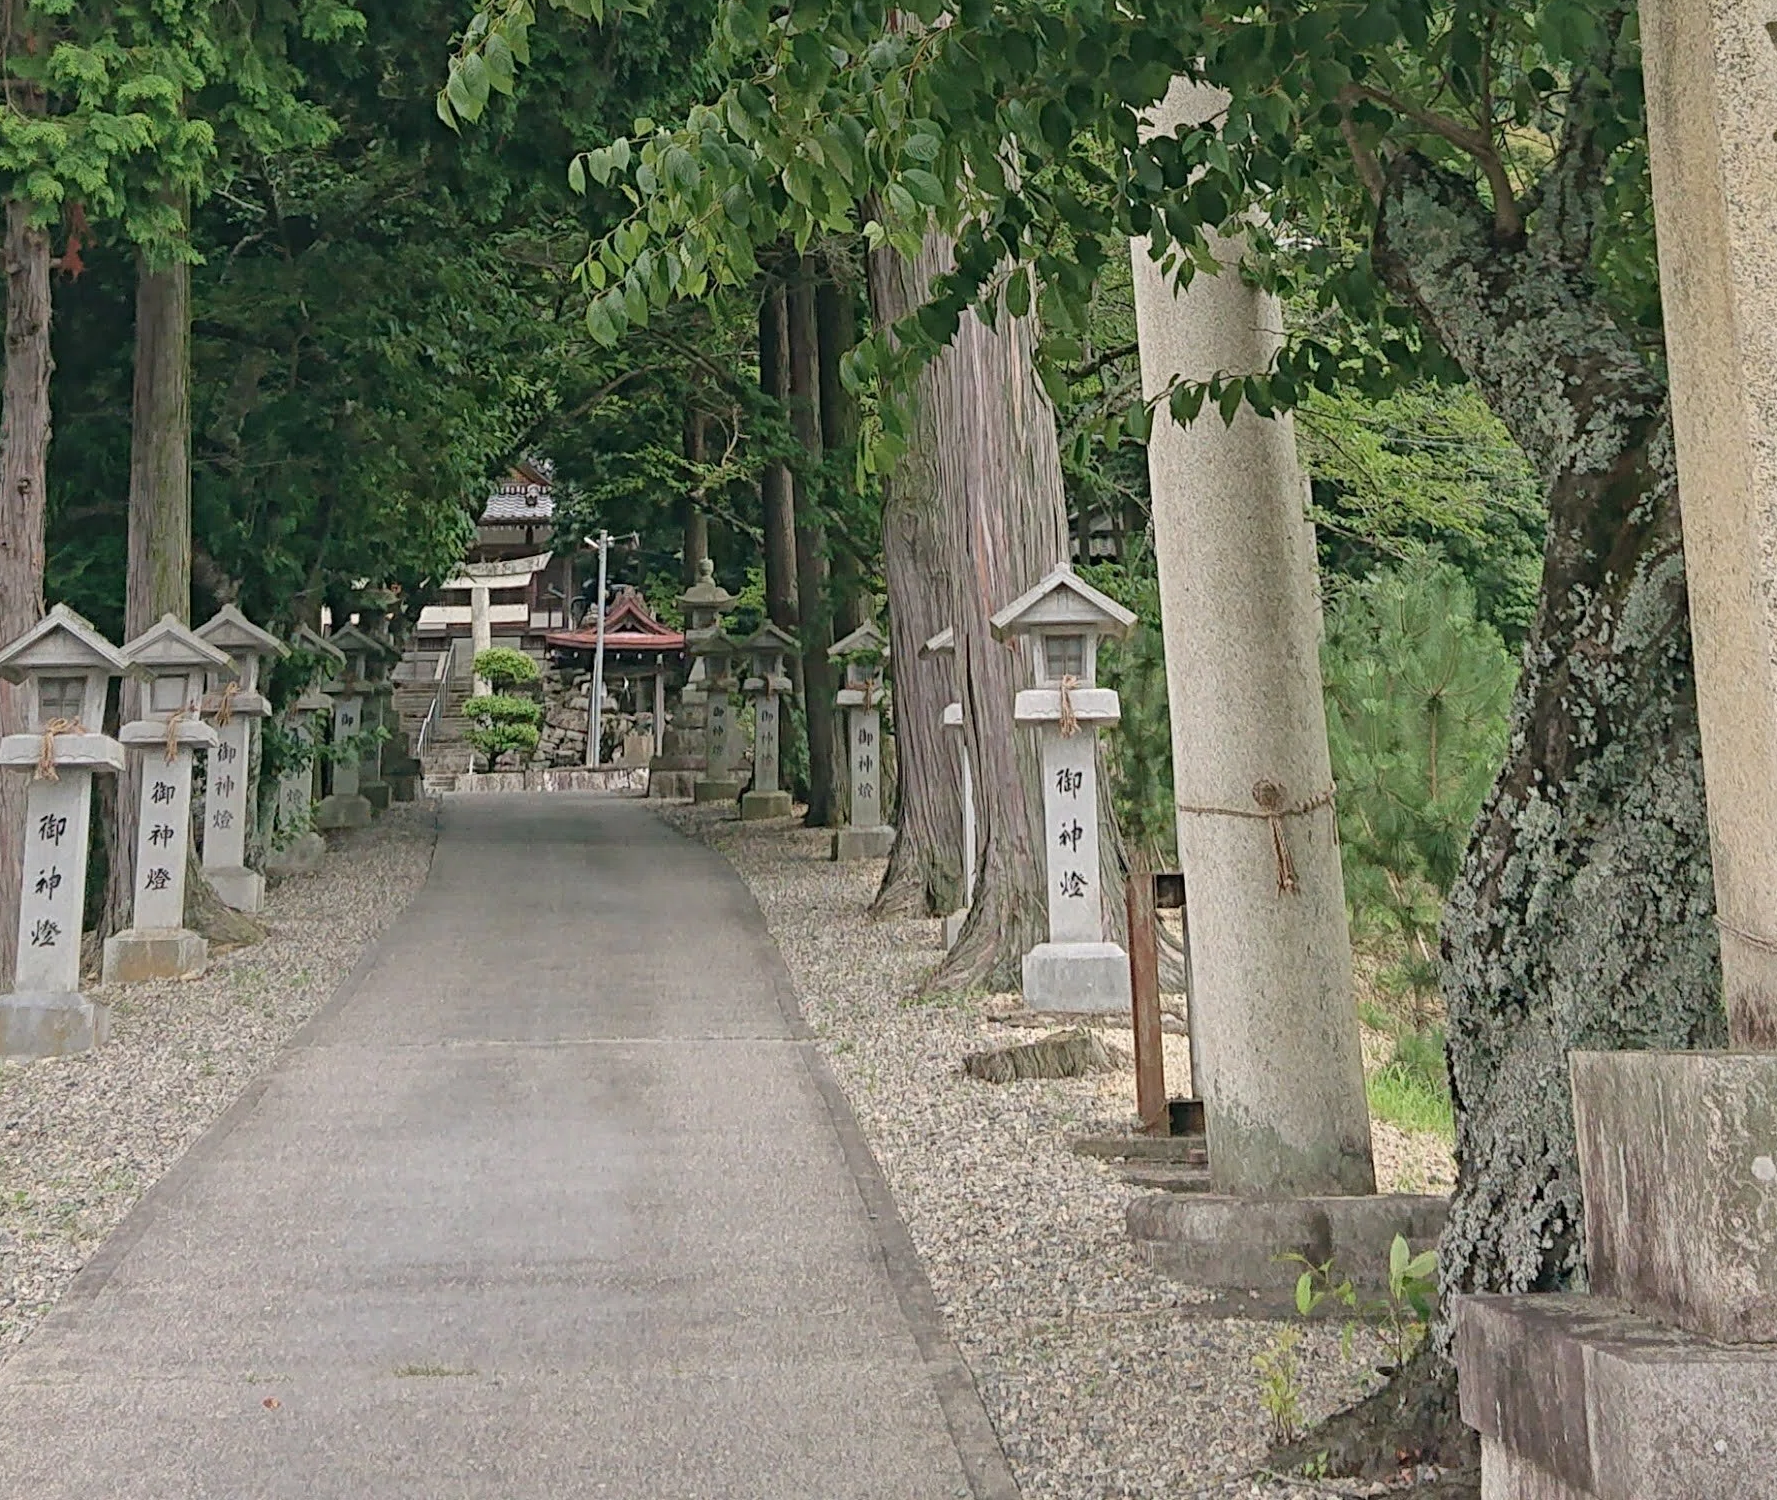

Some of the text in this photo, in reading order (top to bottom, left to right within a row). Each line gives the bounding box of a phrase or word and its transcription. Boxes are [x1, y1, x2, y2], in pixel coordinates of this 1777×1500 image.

[144, 781, 176, 891] 御神燈
[212, 742, 237, 831] 御神燈
[1055, 767, 1088, 900] 御神燈
[30, 813, 66, 948] 御神燈
